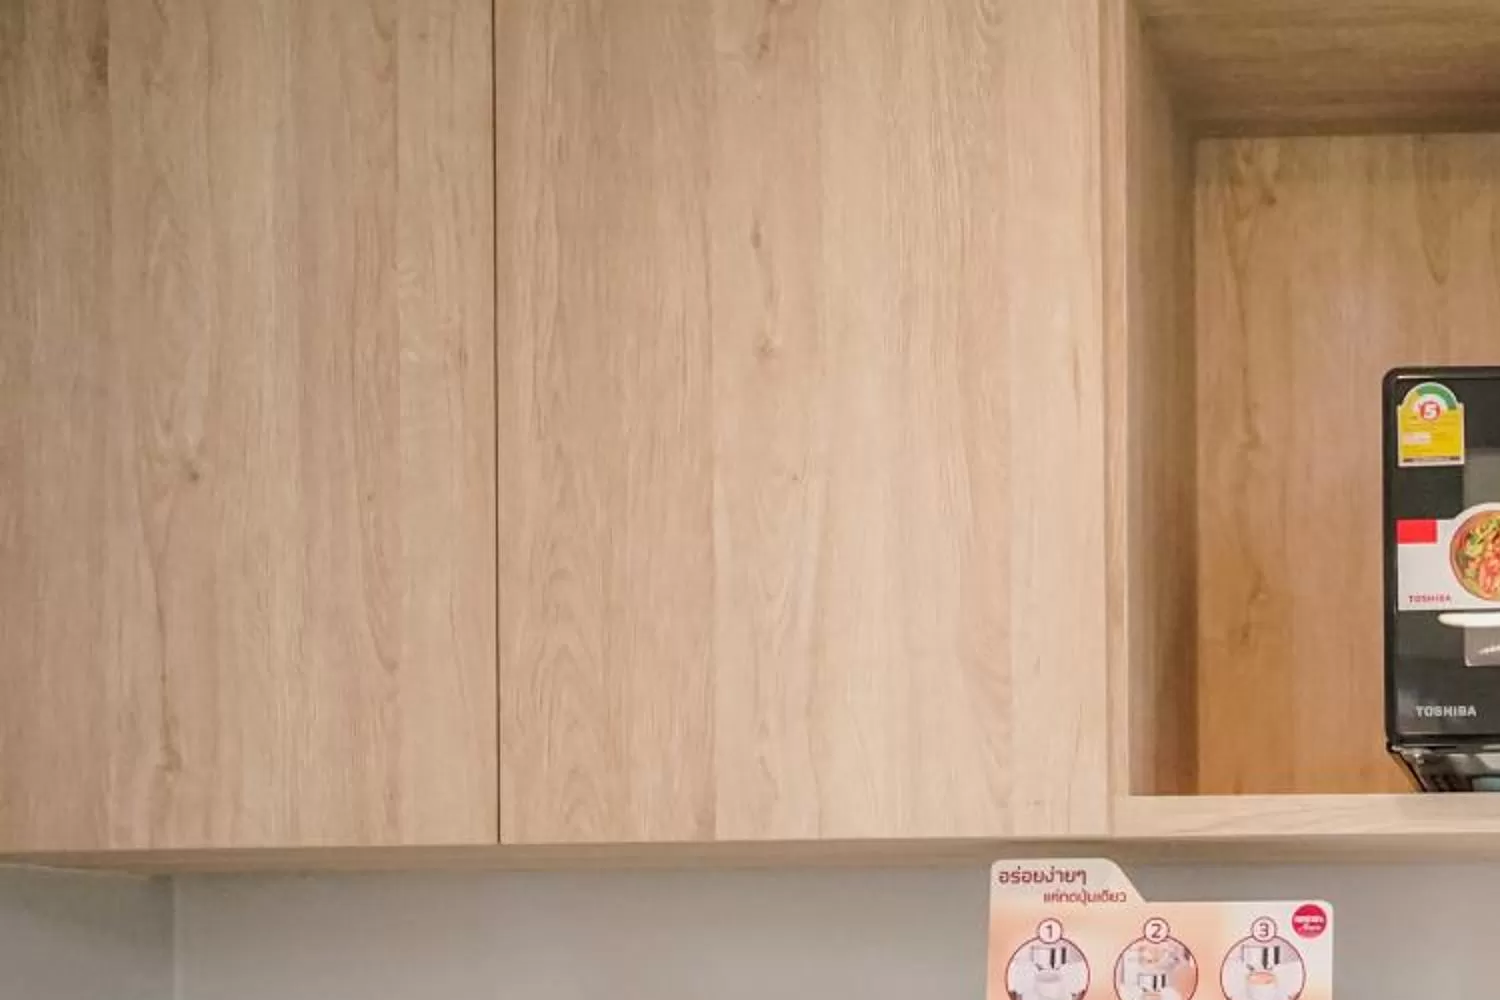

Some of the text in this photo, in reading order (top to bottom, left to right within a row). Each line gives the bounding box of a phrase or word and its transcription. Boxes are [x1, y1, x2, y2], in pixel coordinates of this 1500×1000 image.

[1423, 403, 1438, 418] 5
[1415, 705, 1477, 718] TOSHIBA
[998, 865, 1087, 885] อร่อยง่ายๆ
[1151, 923, 1162, 939] 2
[1259, 923, 1269, 938] 3
